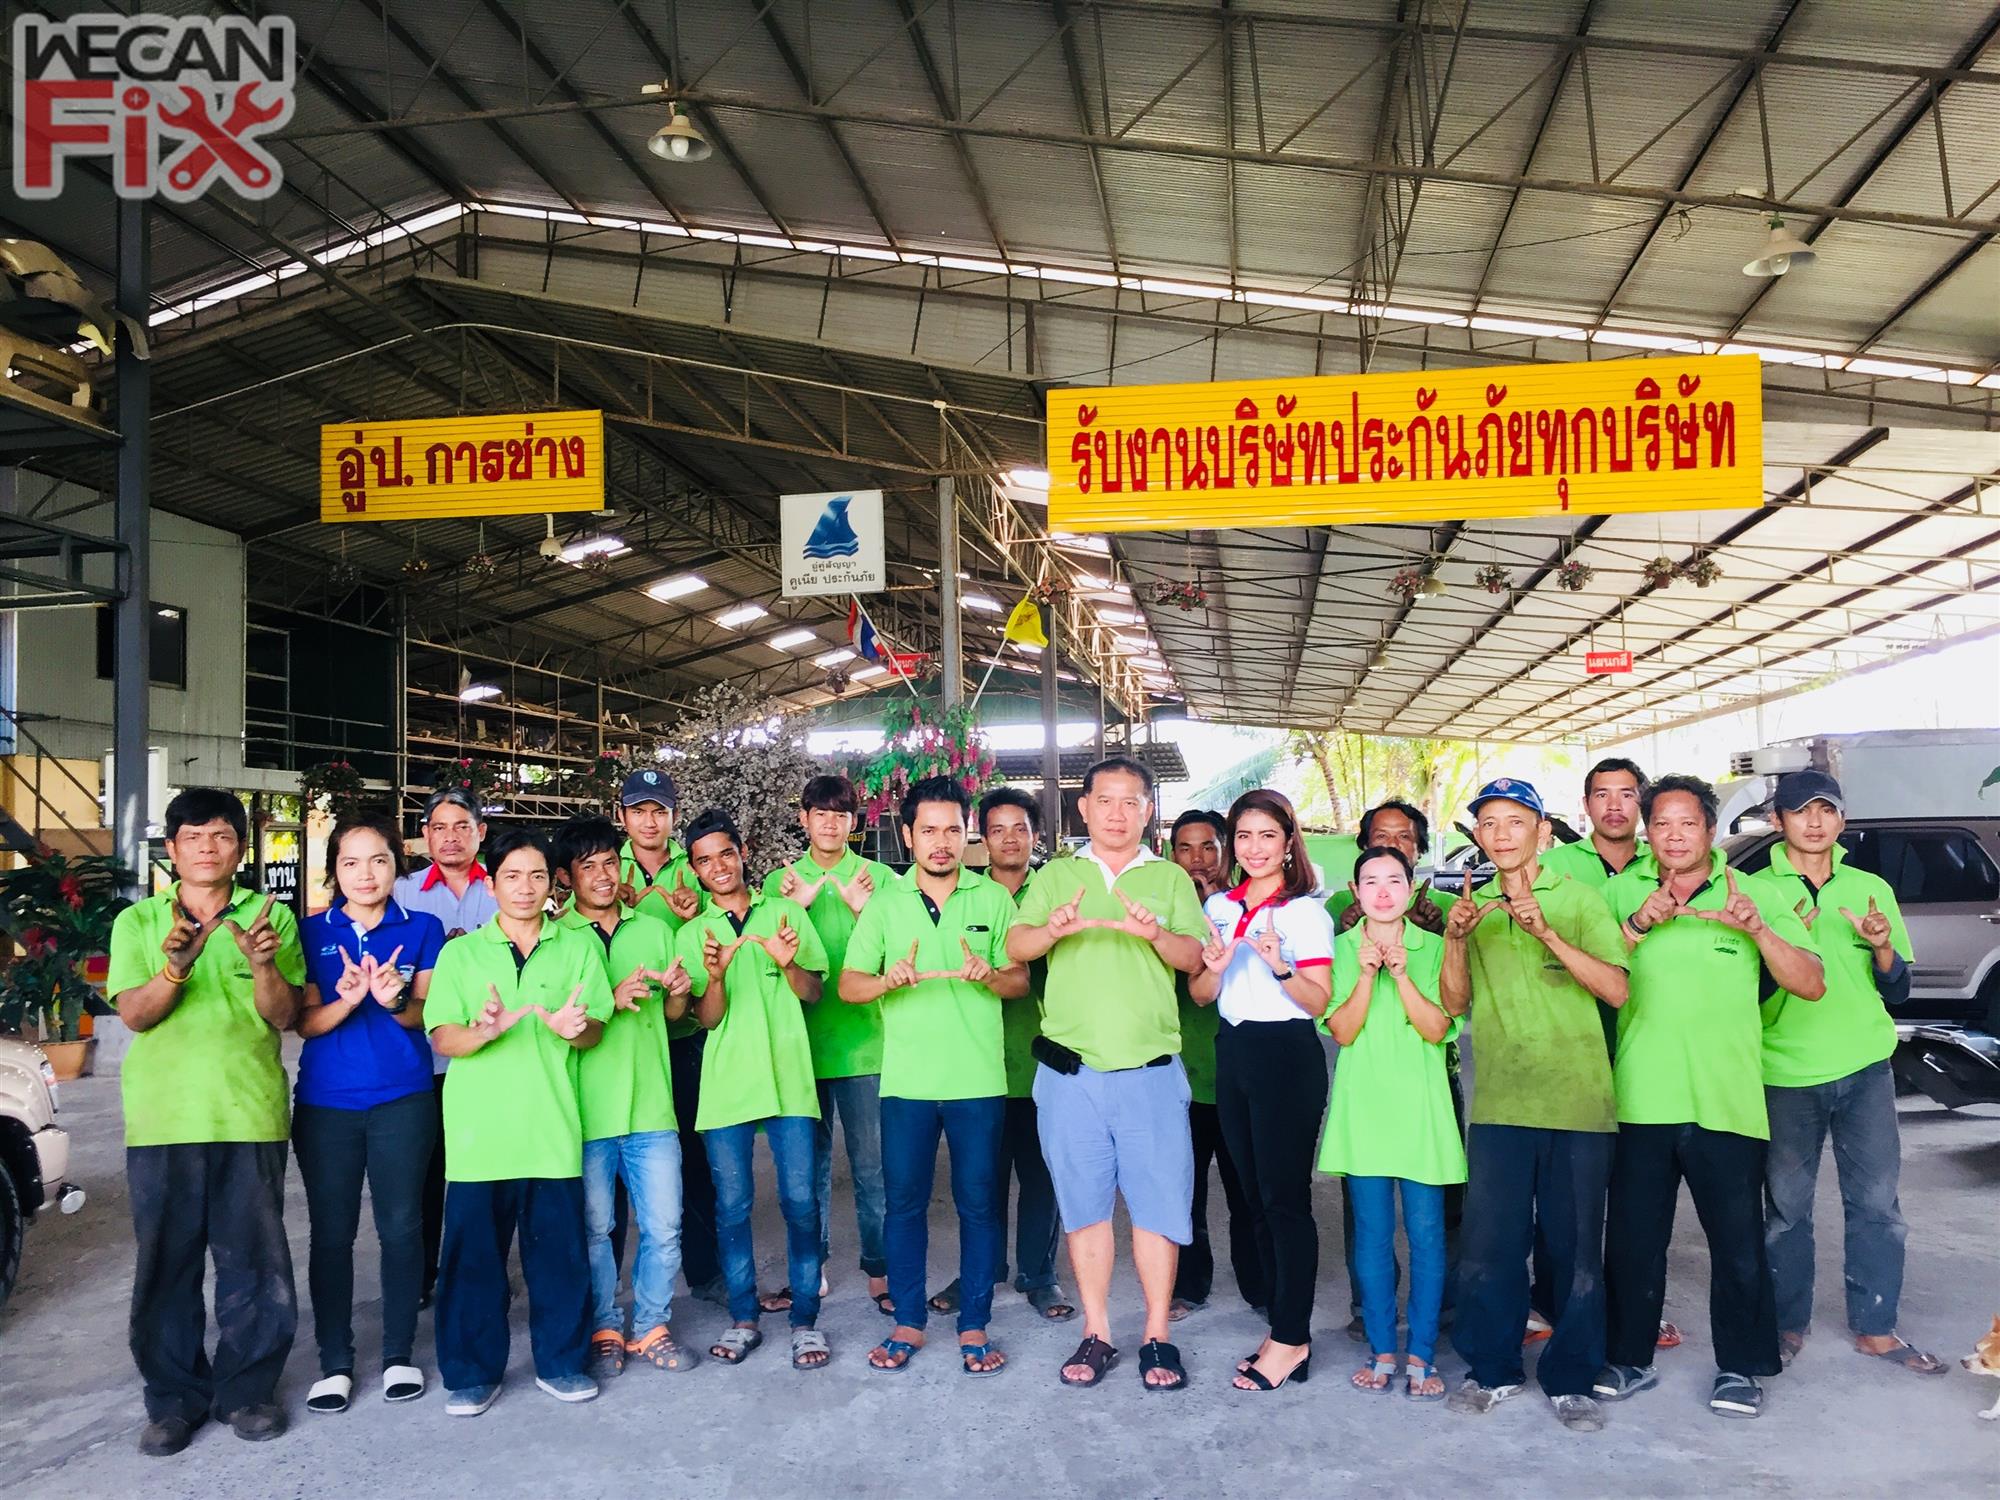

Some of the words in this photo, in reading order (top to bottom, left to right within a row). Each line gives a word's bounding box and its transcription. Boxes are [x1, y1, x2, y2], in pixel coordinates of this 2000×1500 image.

[425, 422, 585, 484] การช่าง
[1071, 373, 1735, 511] รับงานบริษัทประกันภัยทุกบริษัท
[823, 570, 876, 584] ประกันภัย
